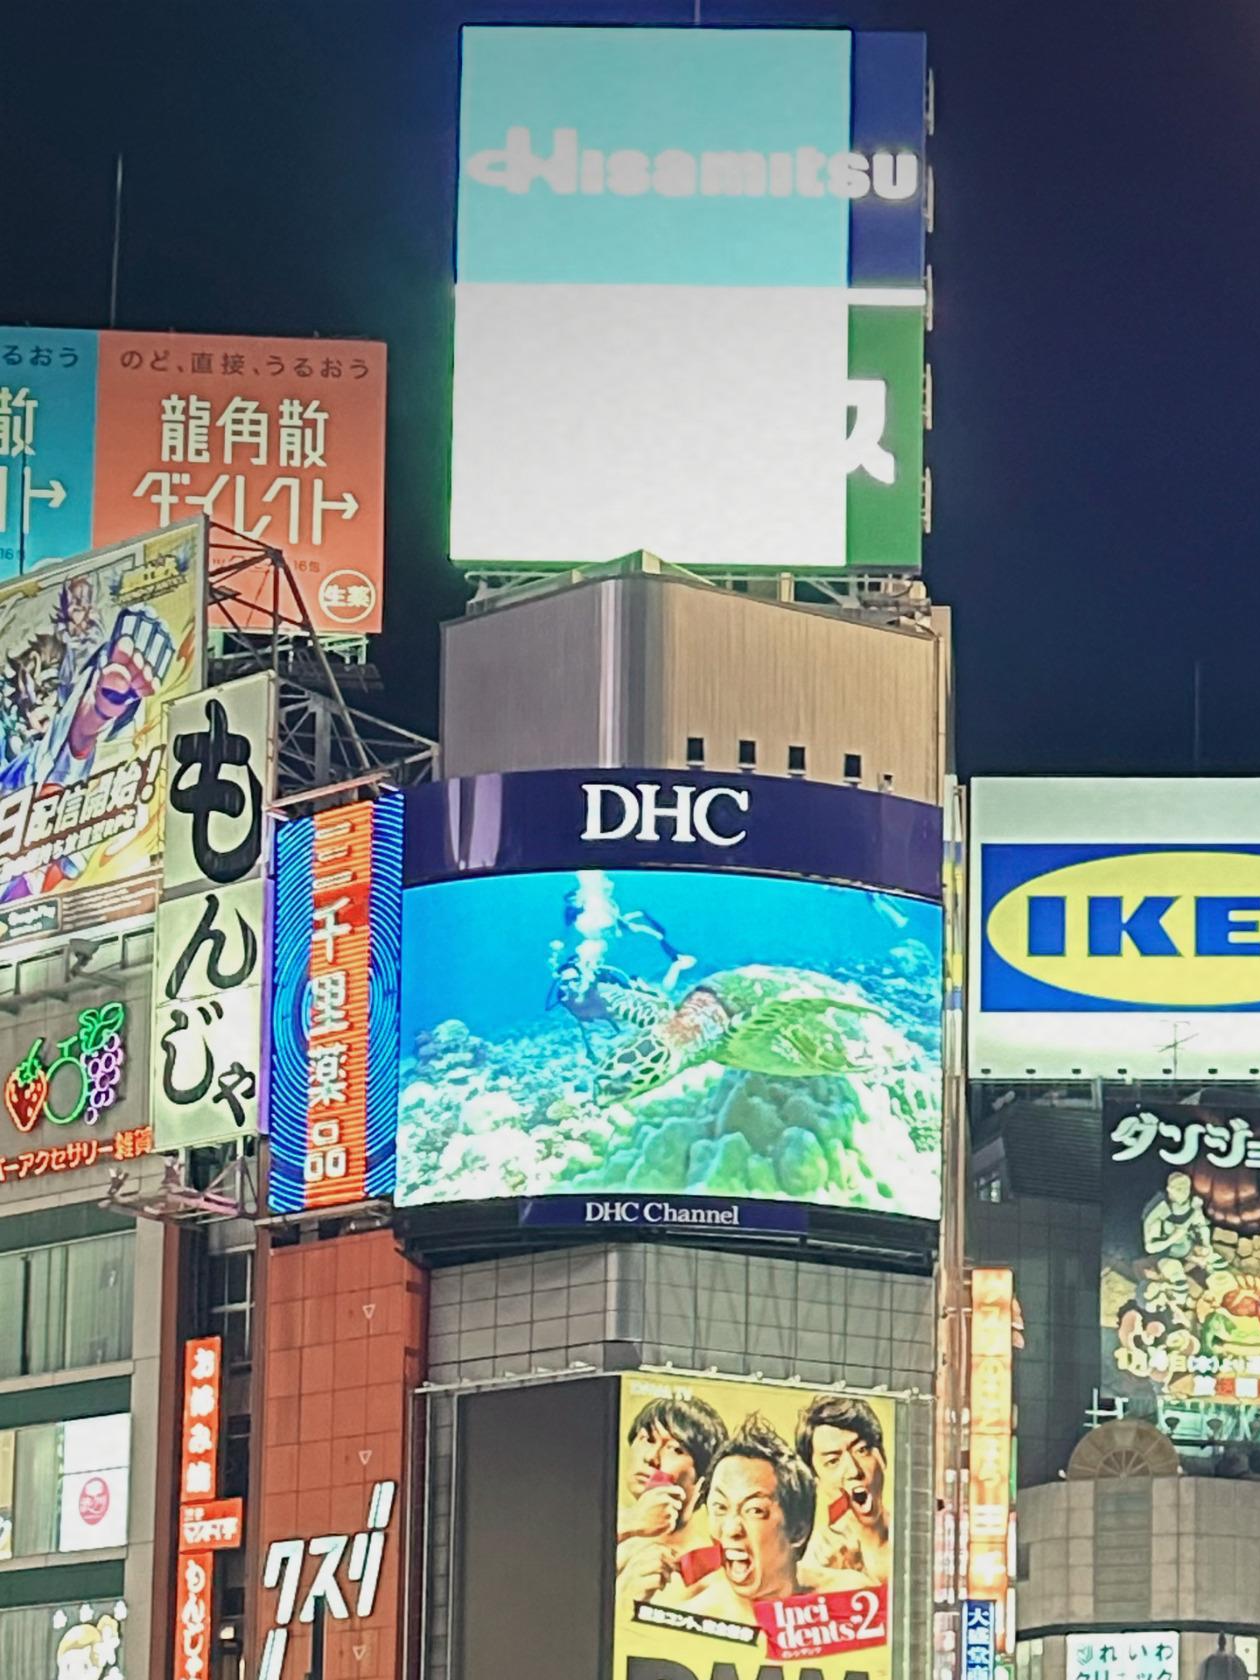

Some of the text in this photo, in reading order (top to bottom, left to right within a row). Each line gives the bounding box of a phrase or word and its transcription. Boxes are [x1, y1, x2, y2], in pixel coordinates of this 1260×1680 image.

[467, 126, 919, 200] Hisamitsu
[119, 350, 370, 379] のど、直接、うるおう
[160, 393, 329, 469] 龍角散
[132, 471, 359, 547] ダイレクト
[580, 782, 751, 848] DHC
[162, 698, 263, 1127] もんじゃ
[303, 820, 353, 1182] 三千里薬品
[584, 1201, 741, 1226] DHC Channel
[772, 1595, 829, 1627] Inci
[776, 1618, 854, 1651] dents
[1100, 1642, 1174, 1662] れいわ
